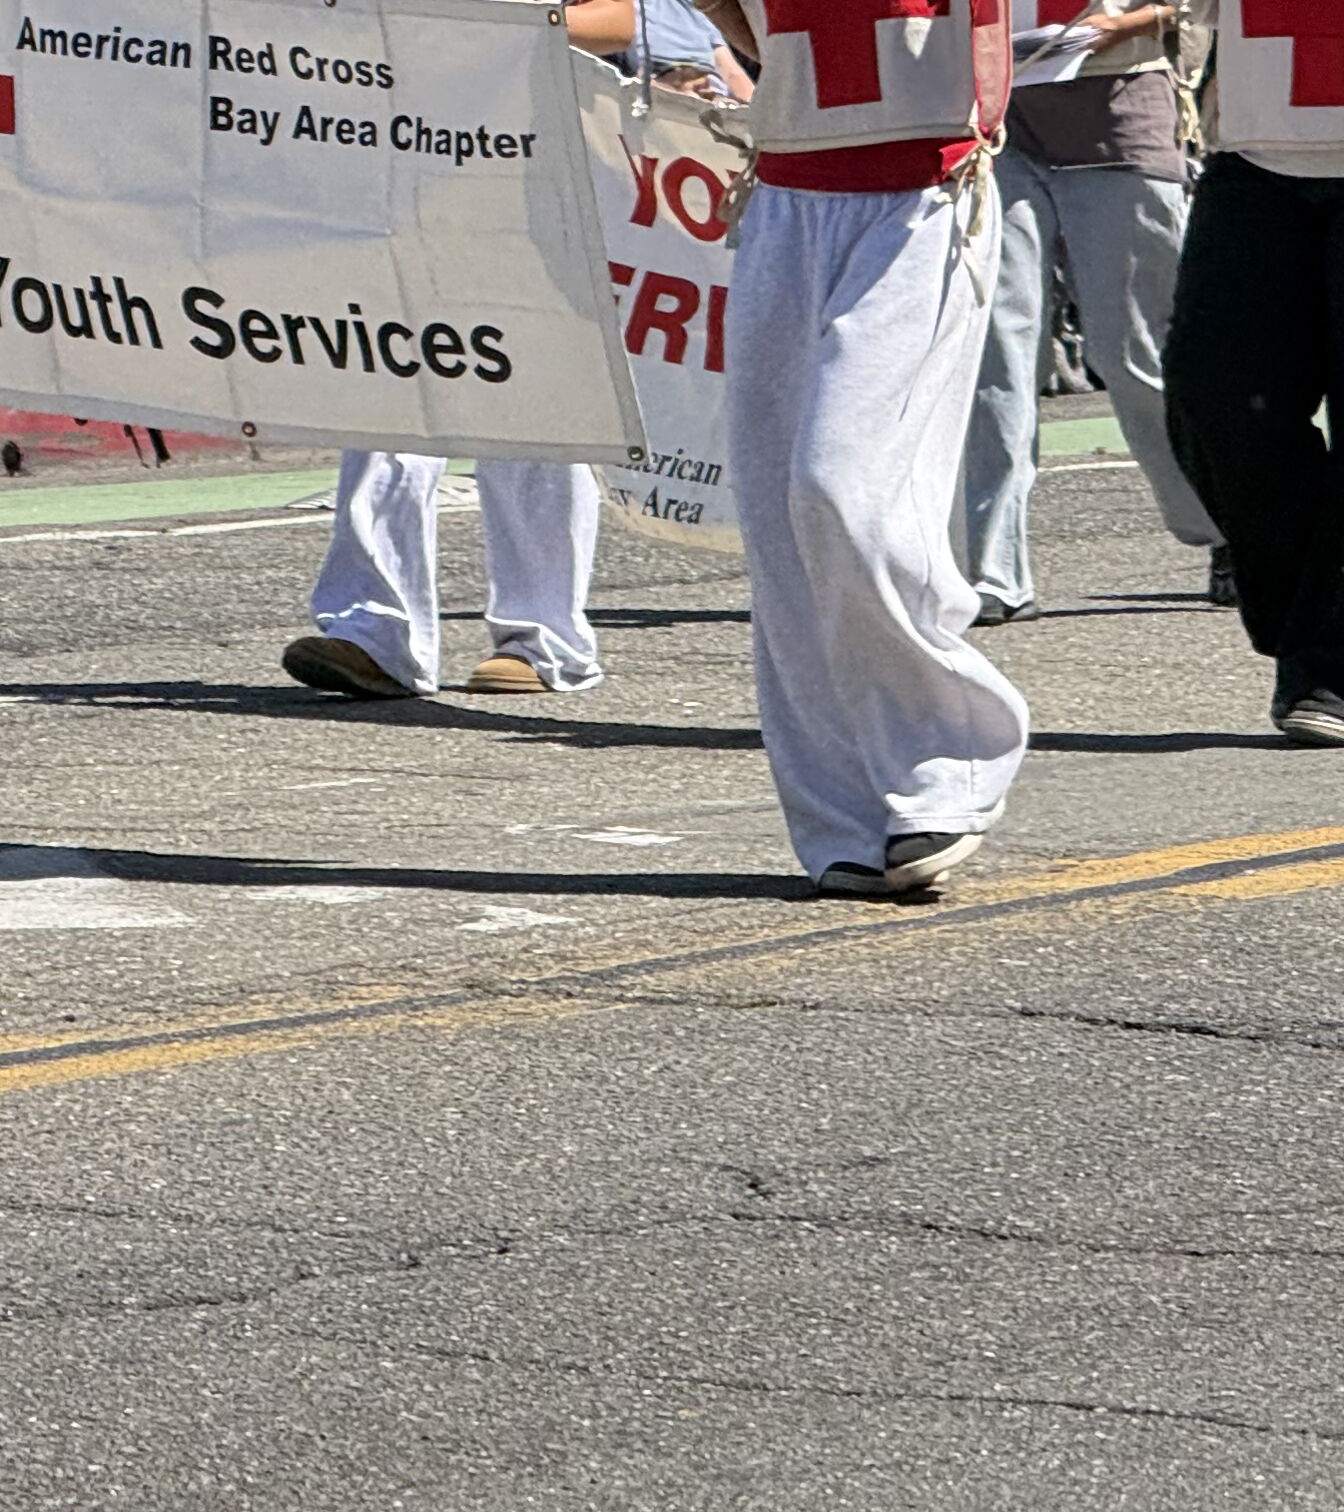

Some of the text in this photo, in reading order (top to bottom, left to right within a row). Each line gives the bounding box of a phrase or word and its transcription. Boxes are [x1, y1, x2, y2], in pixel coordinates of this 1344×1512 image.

[15, 16, 395, 90] American Red Cross
[209, 95, 538, 167] Bay Area Chapter
[618, 133, 739, 243] YO
[181, 284, 514, 384] Services
[616, 448, 723, 486] erican
[641, 485, 705, 525] Area
